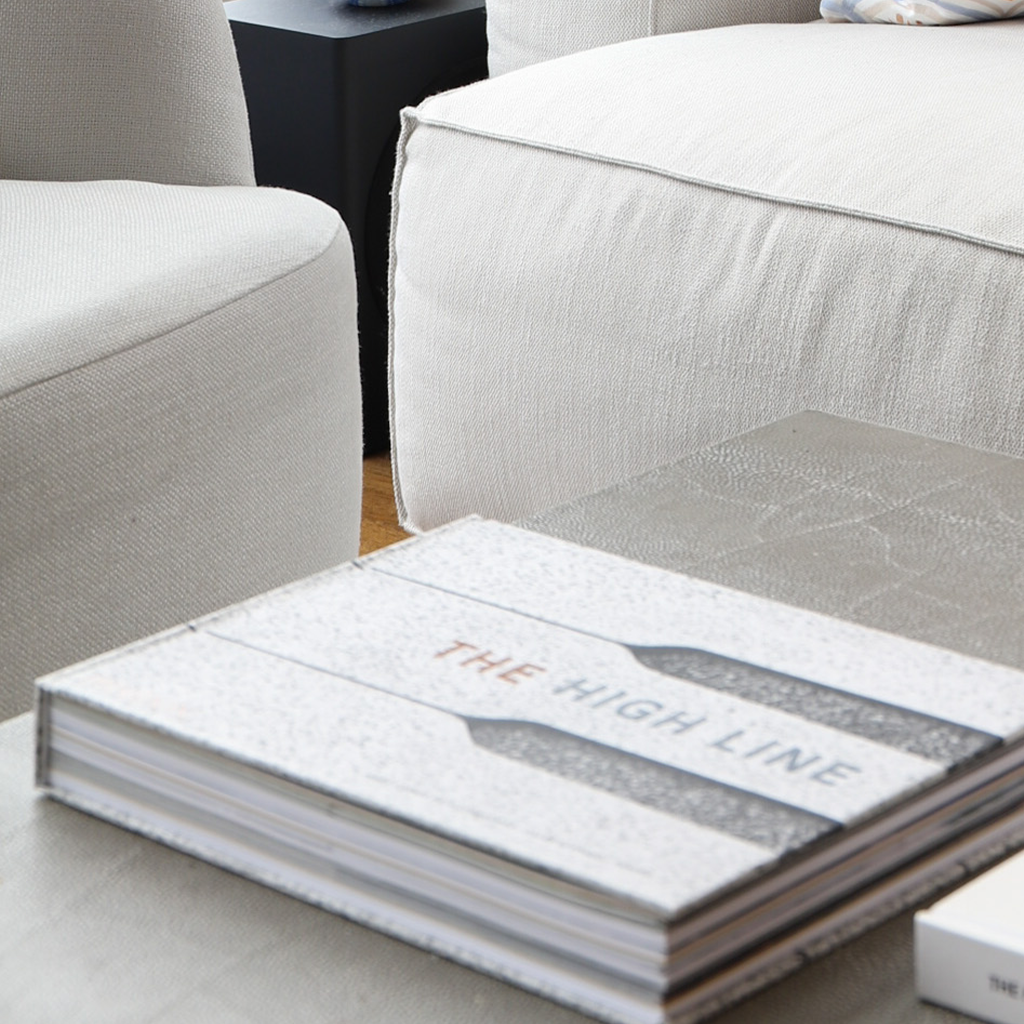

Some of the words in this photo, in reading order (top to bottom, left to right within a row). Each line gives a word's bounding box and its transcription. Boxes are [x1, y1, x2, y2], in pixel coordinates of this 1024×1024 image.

[436, 640, 546, 685] THE
[553, 677, 707, 735] HIGH
[709, 731, 863, 787] LINE
